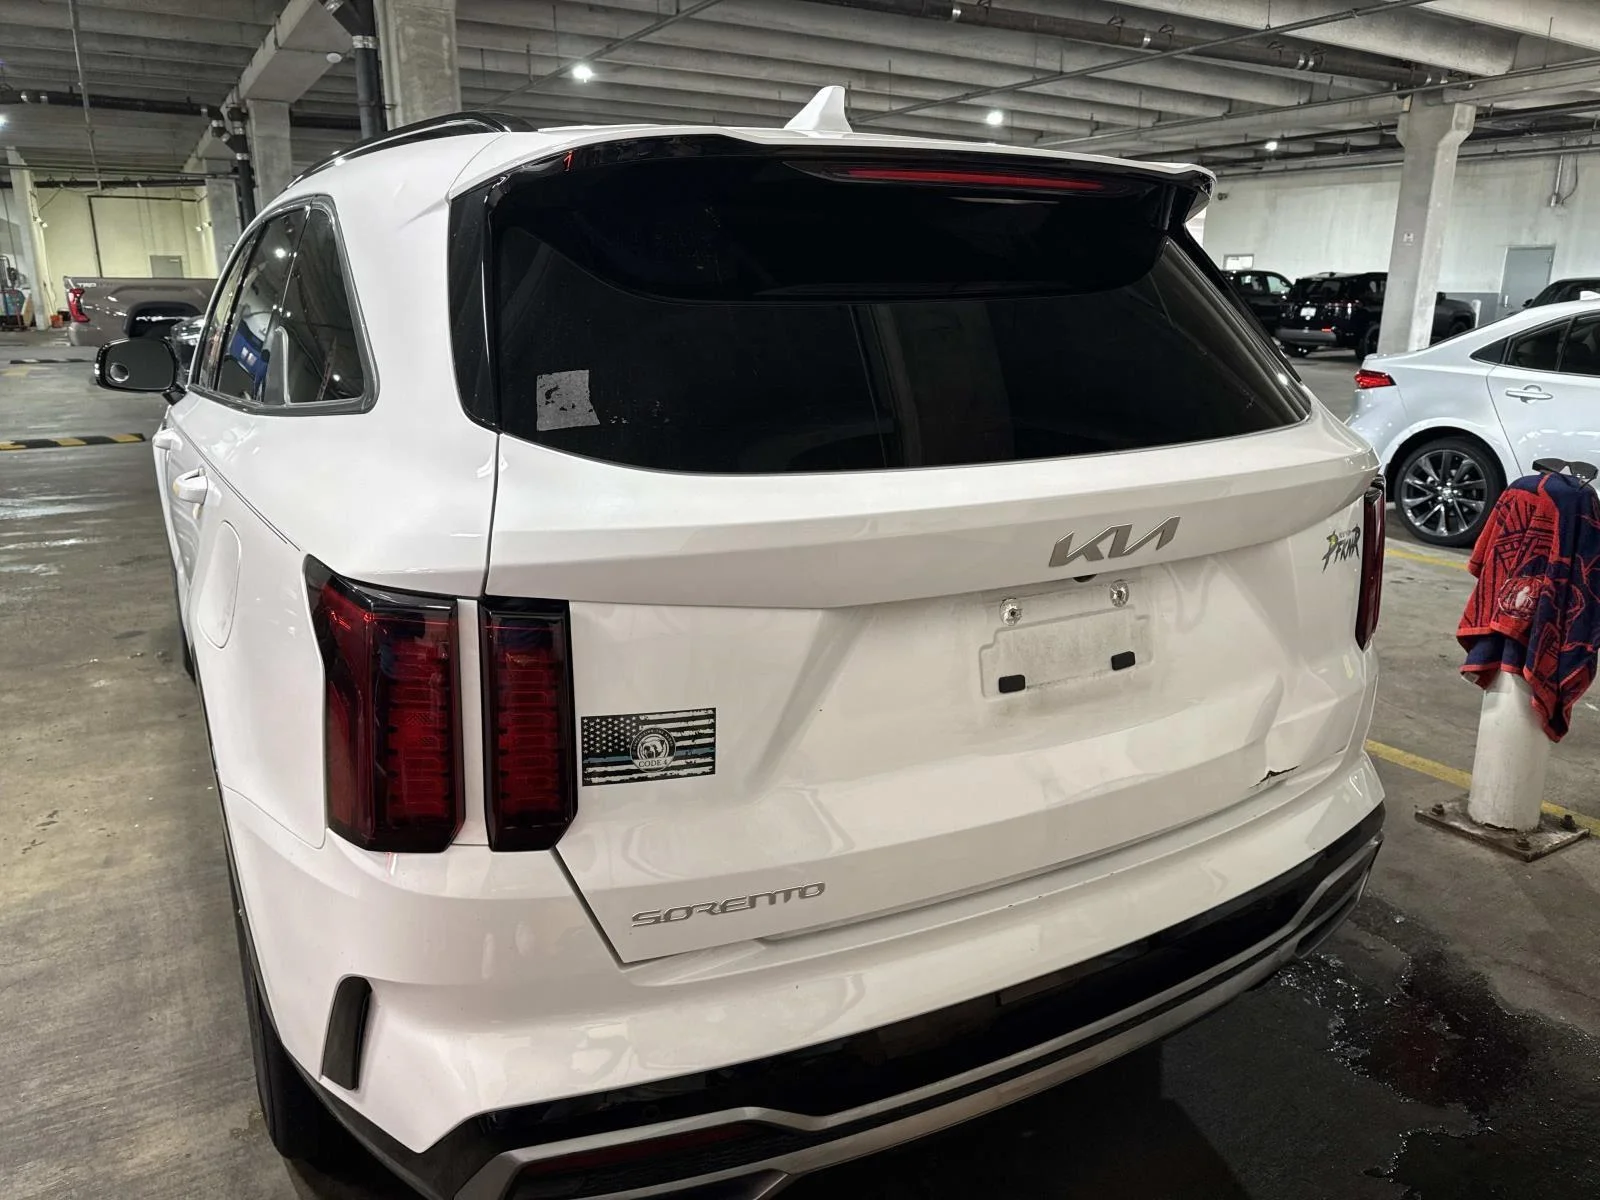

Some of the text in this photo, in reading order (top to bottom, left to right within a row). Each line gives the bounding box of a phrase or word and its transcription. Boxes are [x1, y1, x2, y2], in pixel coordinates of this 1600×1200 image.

[1048, 515, 1181, 568] KIA
[638, 759, 662, 768] CODE
[631, 881, 826, 928] SORENTO
